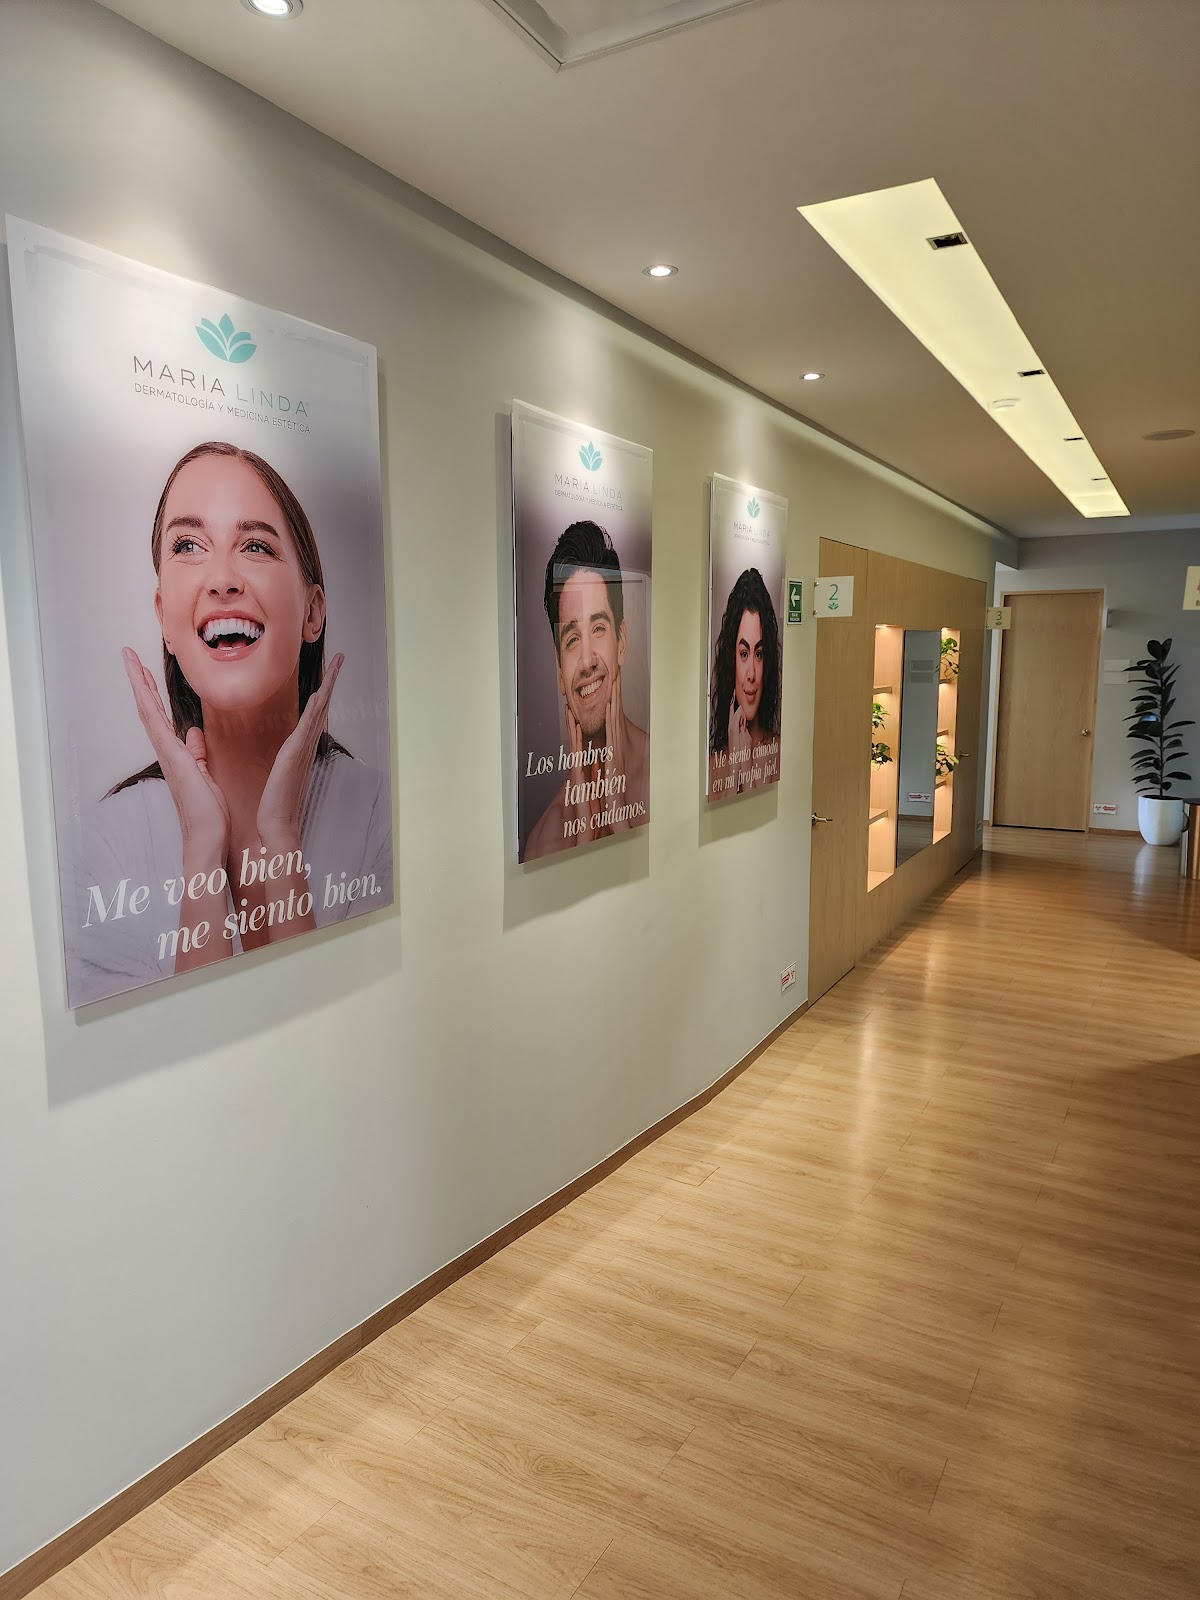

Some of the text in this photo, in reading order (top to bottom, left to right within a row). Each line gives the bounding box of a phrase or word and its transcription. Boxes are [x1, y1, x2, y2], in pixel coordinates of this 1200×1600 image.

[133, 355, 308, 417] MARIA LINDA
[134, 382, 215, 411] DERMATOLOGÍA
[217, 403, 224, 413] Y
[226, 405, 270, 425] MEDICINA
[554, 473, 590, 493] MARIA
[828, 583, 839, 601] 2
[996, 610, 1003, 621] 3
[525, 740, 614, 777] Los hombres
[712, 749, 727, 770] Me
[728, 745, 751, 766] siento
[712, 757, 778, 793] en mi propia piel.
[564, 767, 627, 807] también
[563, 800, 646, 838] nos cuidamos.
[82, 846, 312, 929] Me veo bien,
[157, 871, 382, 961] me siento bien.
